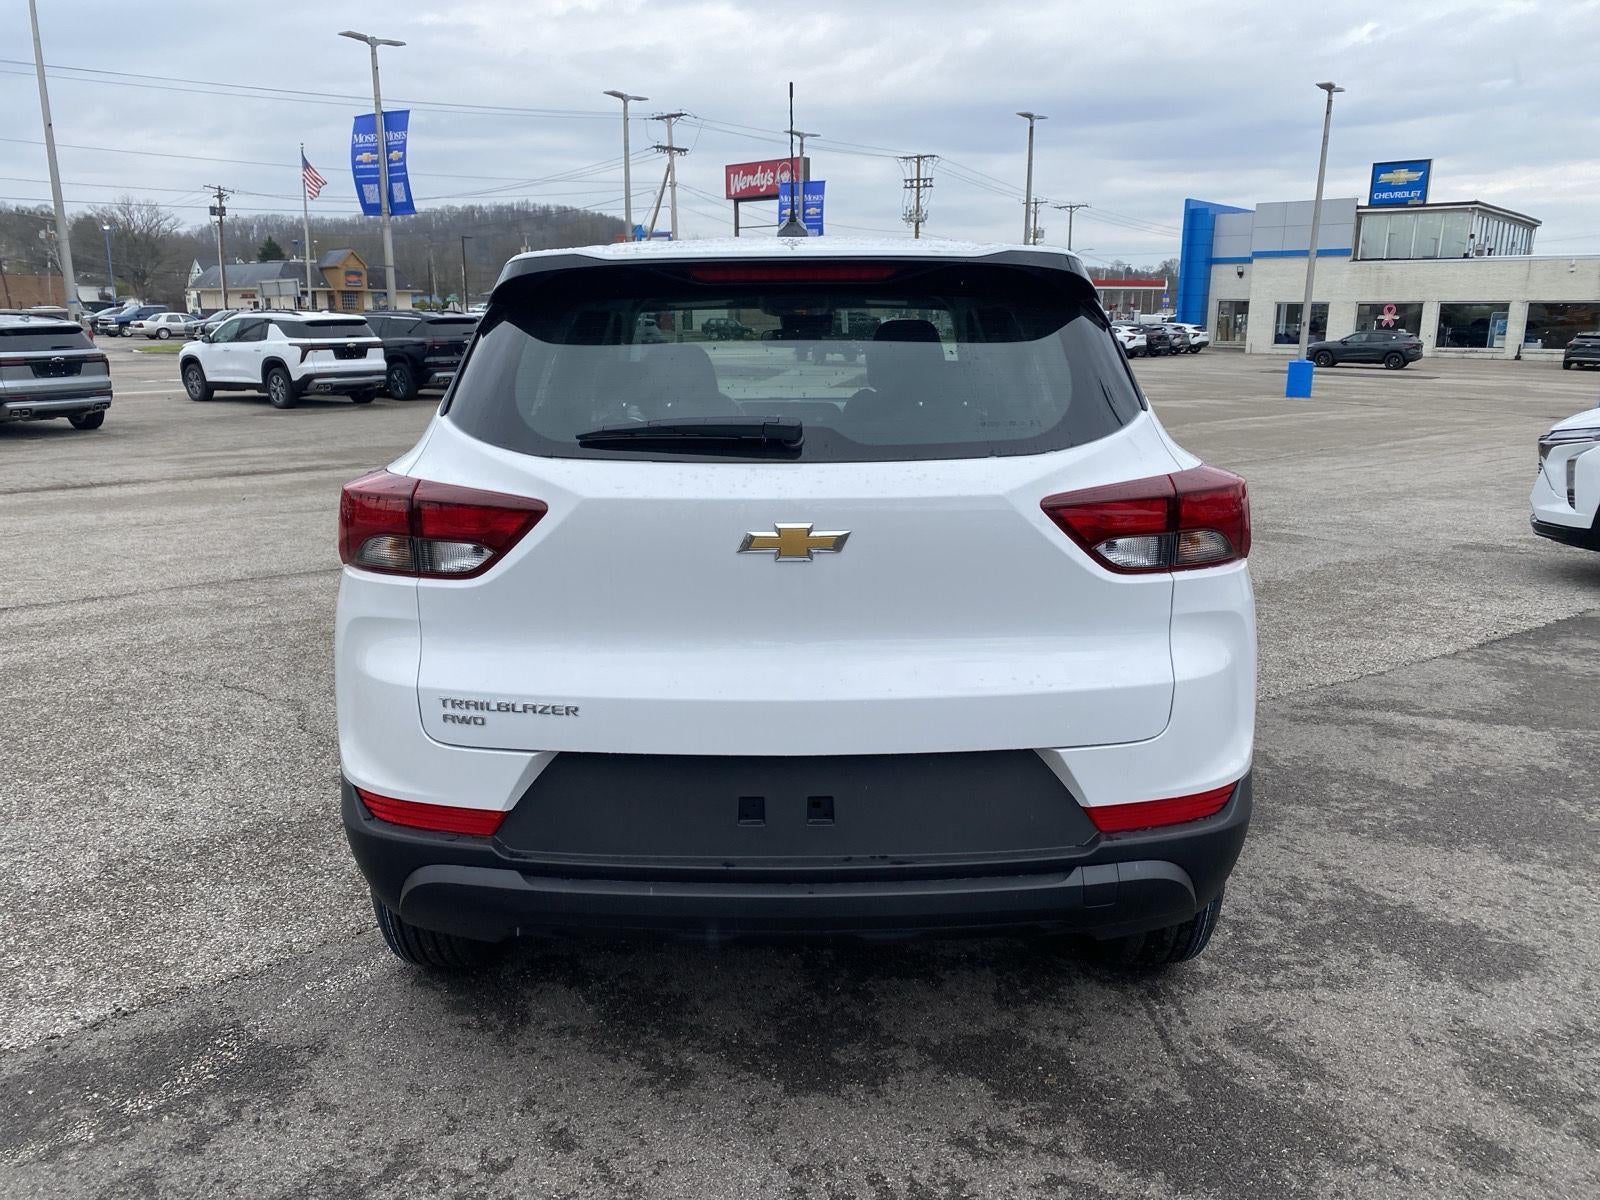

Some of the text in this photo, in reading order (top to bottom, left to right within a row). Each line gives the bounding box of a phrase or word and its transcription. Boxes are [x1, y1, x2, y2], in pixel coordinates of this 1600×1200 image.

[353, 133, 378, 143] MOSE
[730, 166, 774, 195] Wendy's
[1374, 190, 1421, 200] CHEVROLET
[440, 697, 580, 717] TRAILBLAZER
[442, 713, 487, 726] AWD
